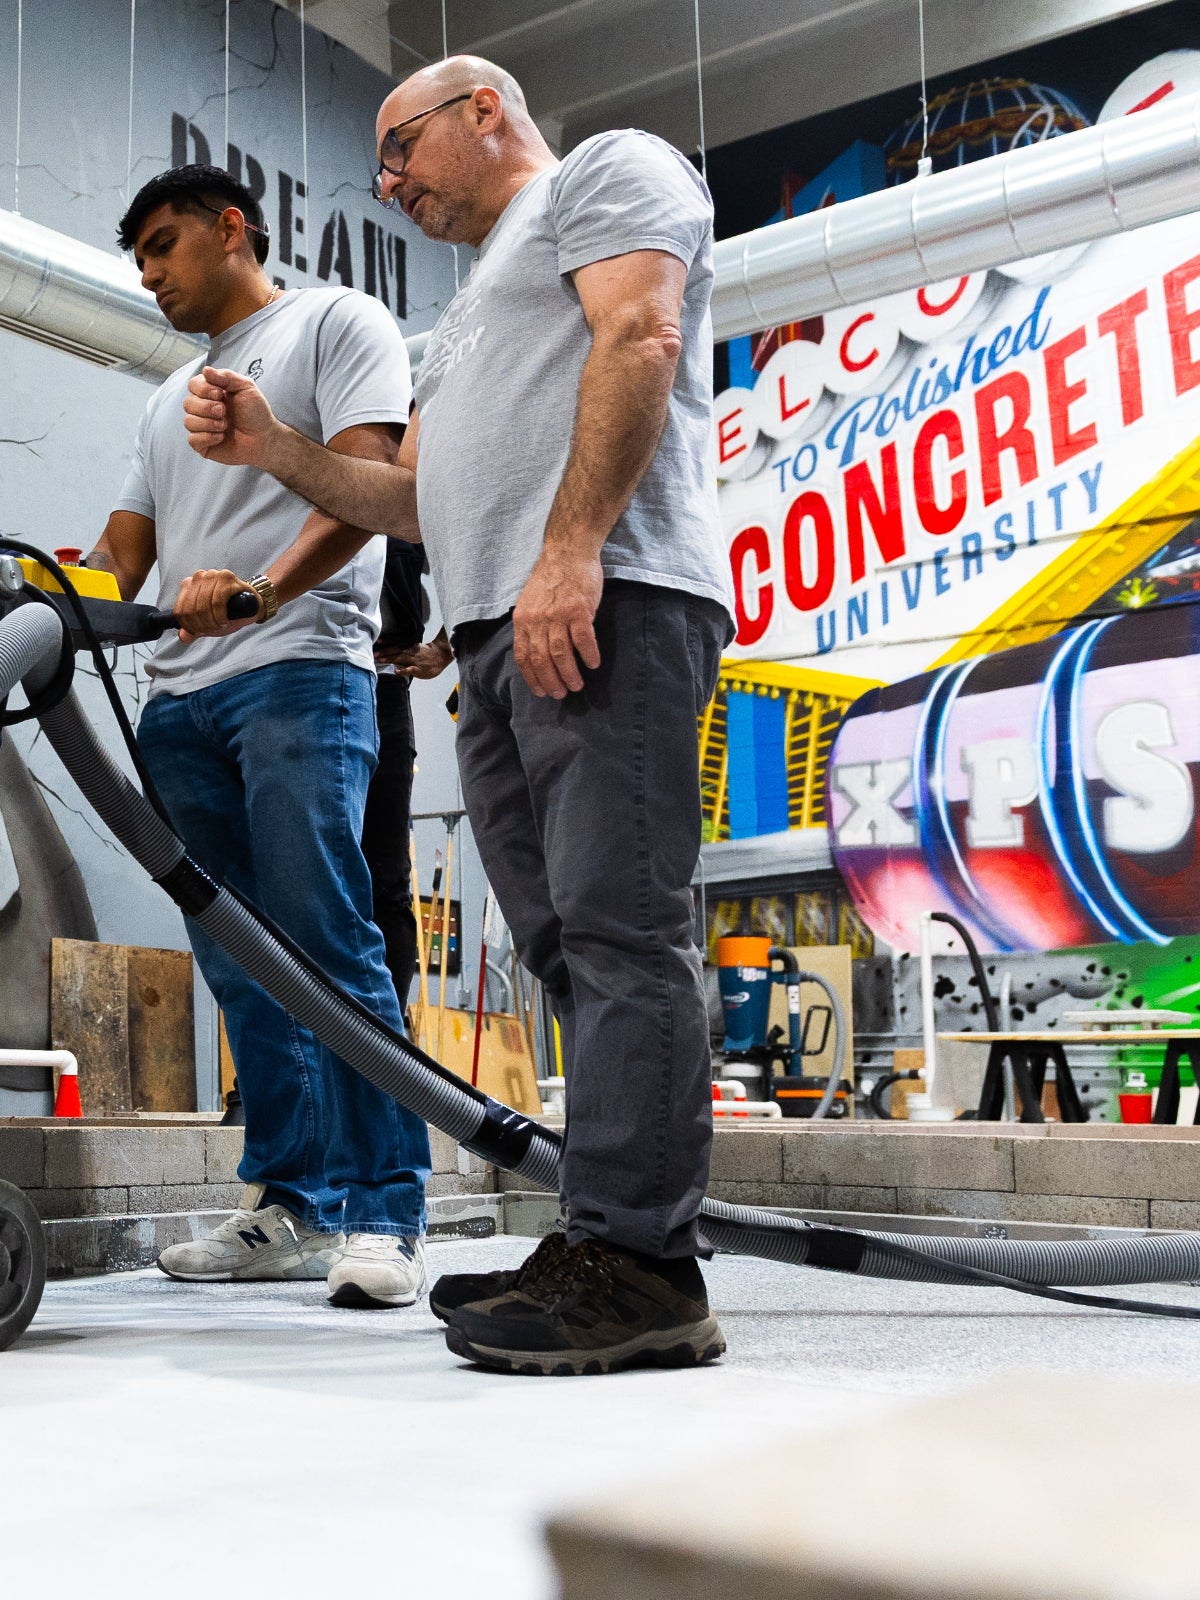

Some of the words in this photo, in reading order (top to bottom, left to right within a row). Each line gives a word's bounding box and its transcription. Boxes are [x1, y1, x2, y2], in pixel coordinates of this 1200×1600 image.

[730, 254, 1200, 647] CONCRETE
[772, 443, 818, 493] TO
[826, 285, 1053, 468] Polished
[815, 461, 1105, 656] UNIVERSITY
[834, 701, 1194, 854] XPS
[237, 1223, 272, 1250] N
